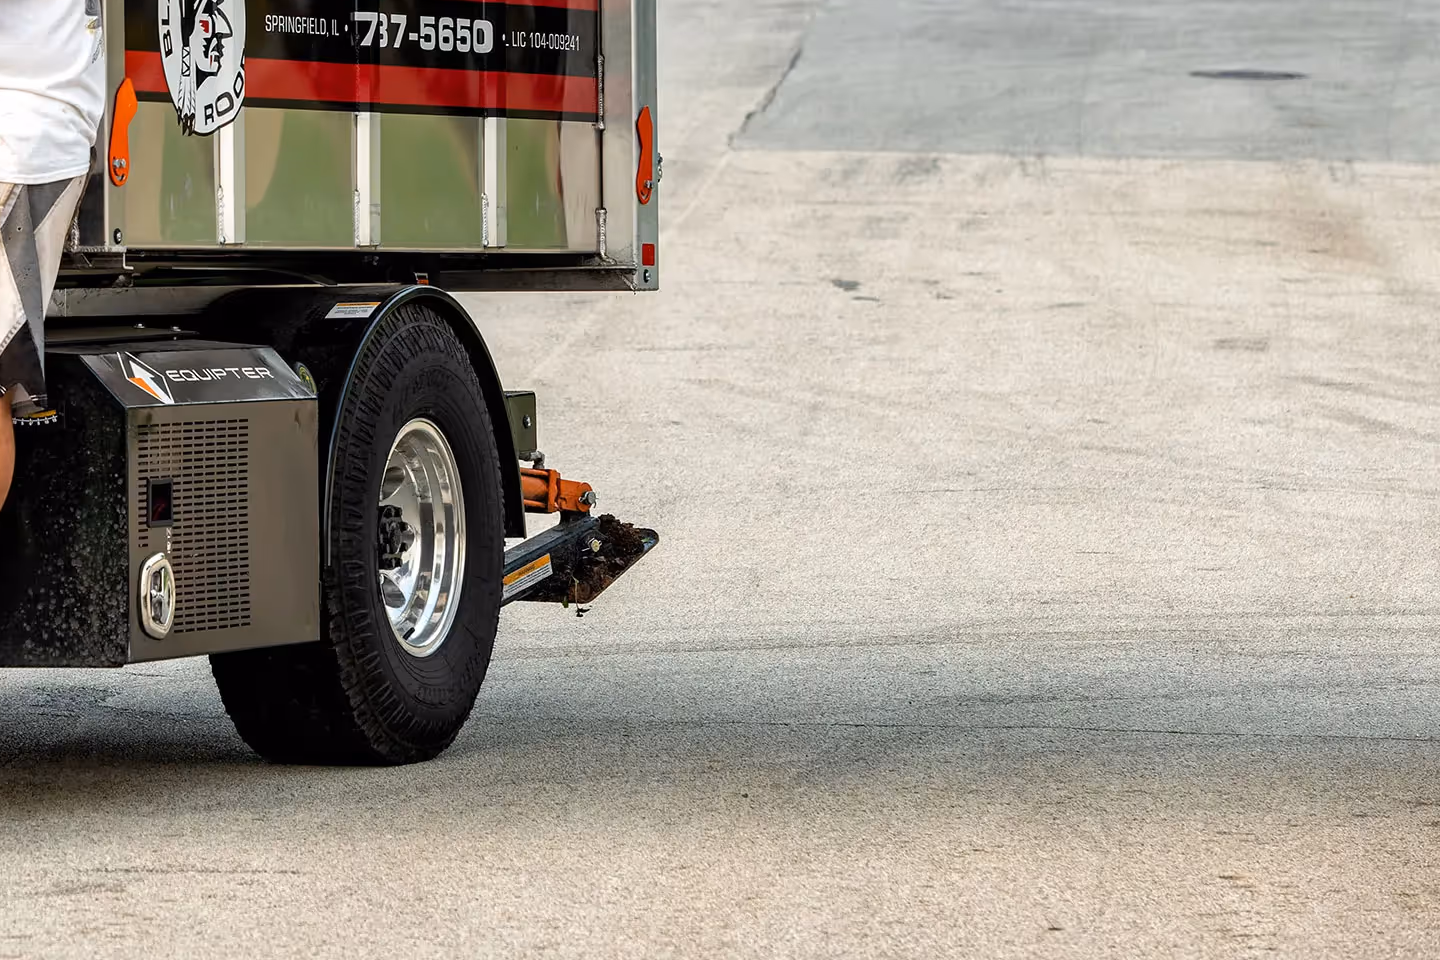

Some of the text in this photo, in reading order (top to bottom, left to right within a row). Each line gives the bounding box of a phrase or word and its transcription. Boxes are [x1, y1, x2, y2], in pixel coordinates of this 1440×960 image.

[265, 14, 329, 38] SPRINGFIELD,
[331, 19, 340, 36] IL
[511, 31, 527, 48] LIC
[203, 50, 246, 126] ROO
[165, 367, 275, 382] EQUIPTER
